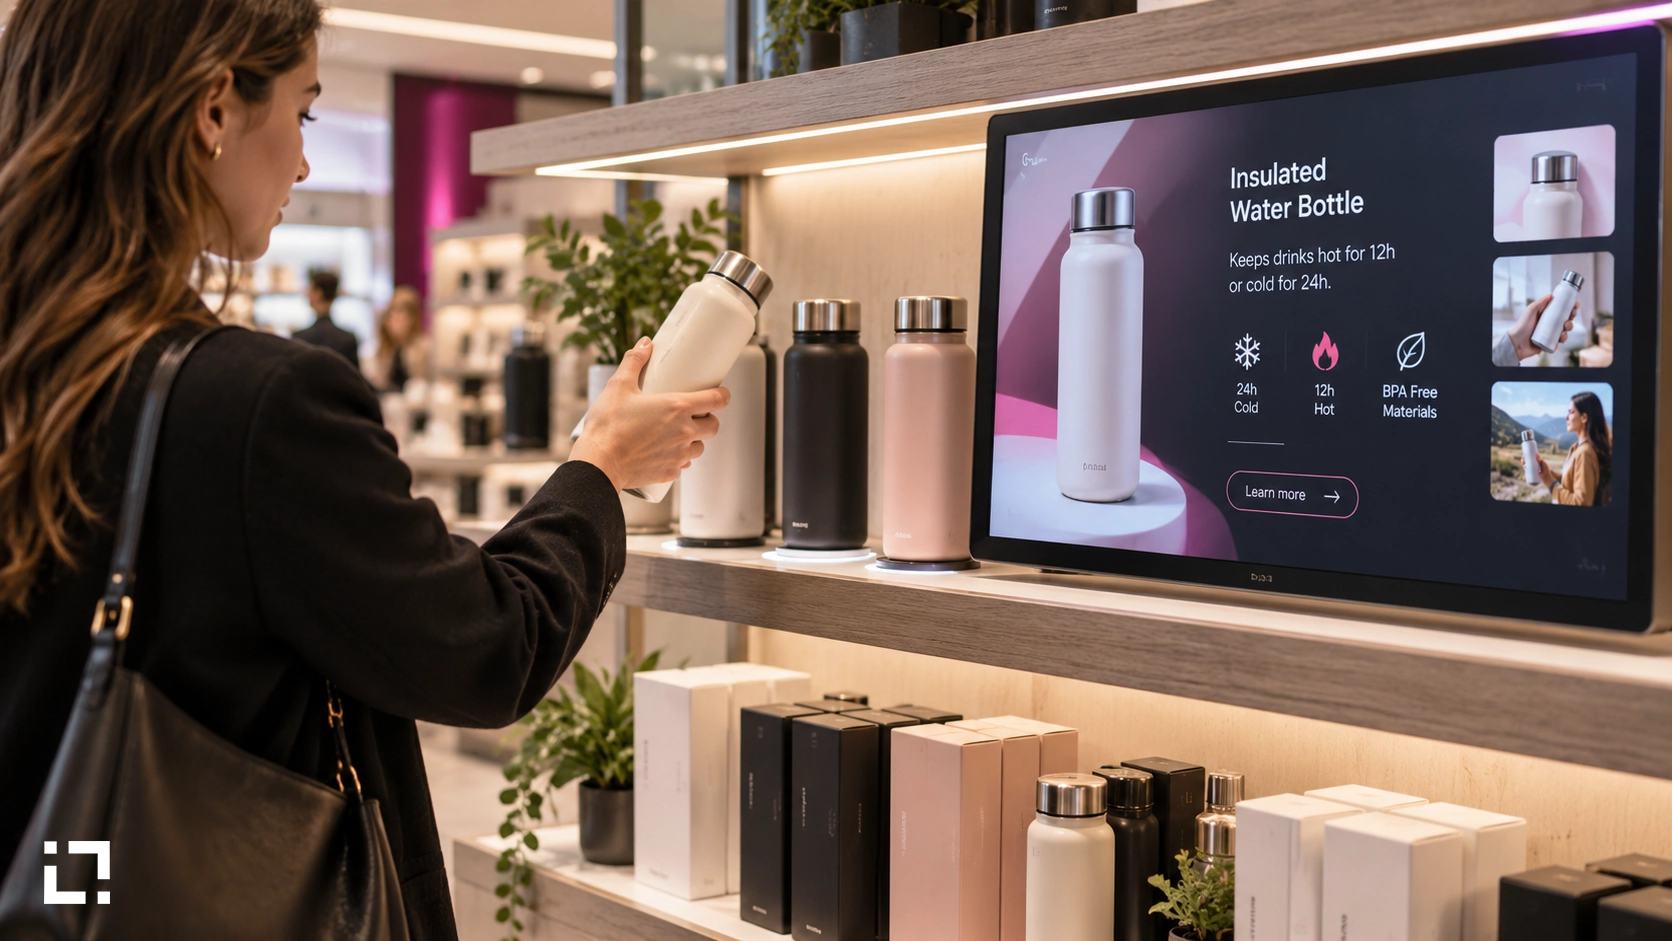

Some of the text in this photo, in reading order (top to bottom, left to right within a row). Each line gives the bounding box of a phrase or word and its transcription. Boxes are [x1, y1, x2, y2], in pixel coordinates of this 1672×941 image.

[1230, 156, 1327, 190] Insulated
[1229, 189, 1365, 223] Water Bottle
[1229, 242, 1396, 271] Keeps drinks hot for 12h
[1228, 273, 1332, 293] or cold for 24h.
[1236, 382, 1258, 396] 24h
[1314, 383, 1335, 397] 12h
[1382, 384, 1438, 399] BPA Free
[1234, 400, 1259, 414] Cold
[1314, 402, 1335, 416] Hot
[1382, 403, 1438, 419] Materials
[1245, 485, 1306, 501] Learn more
